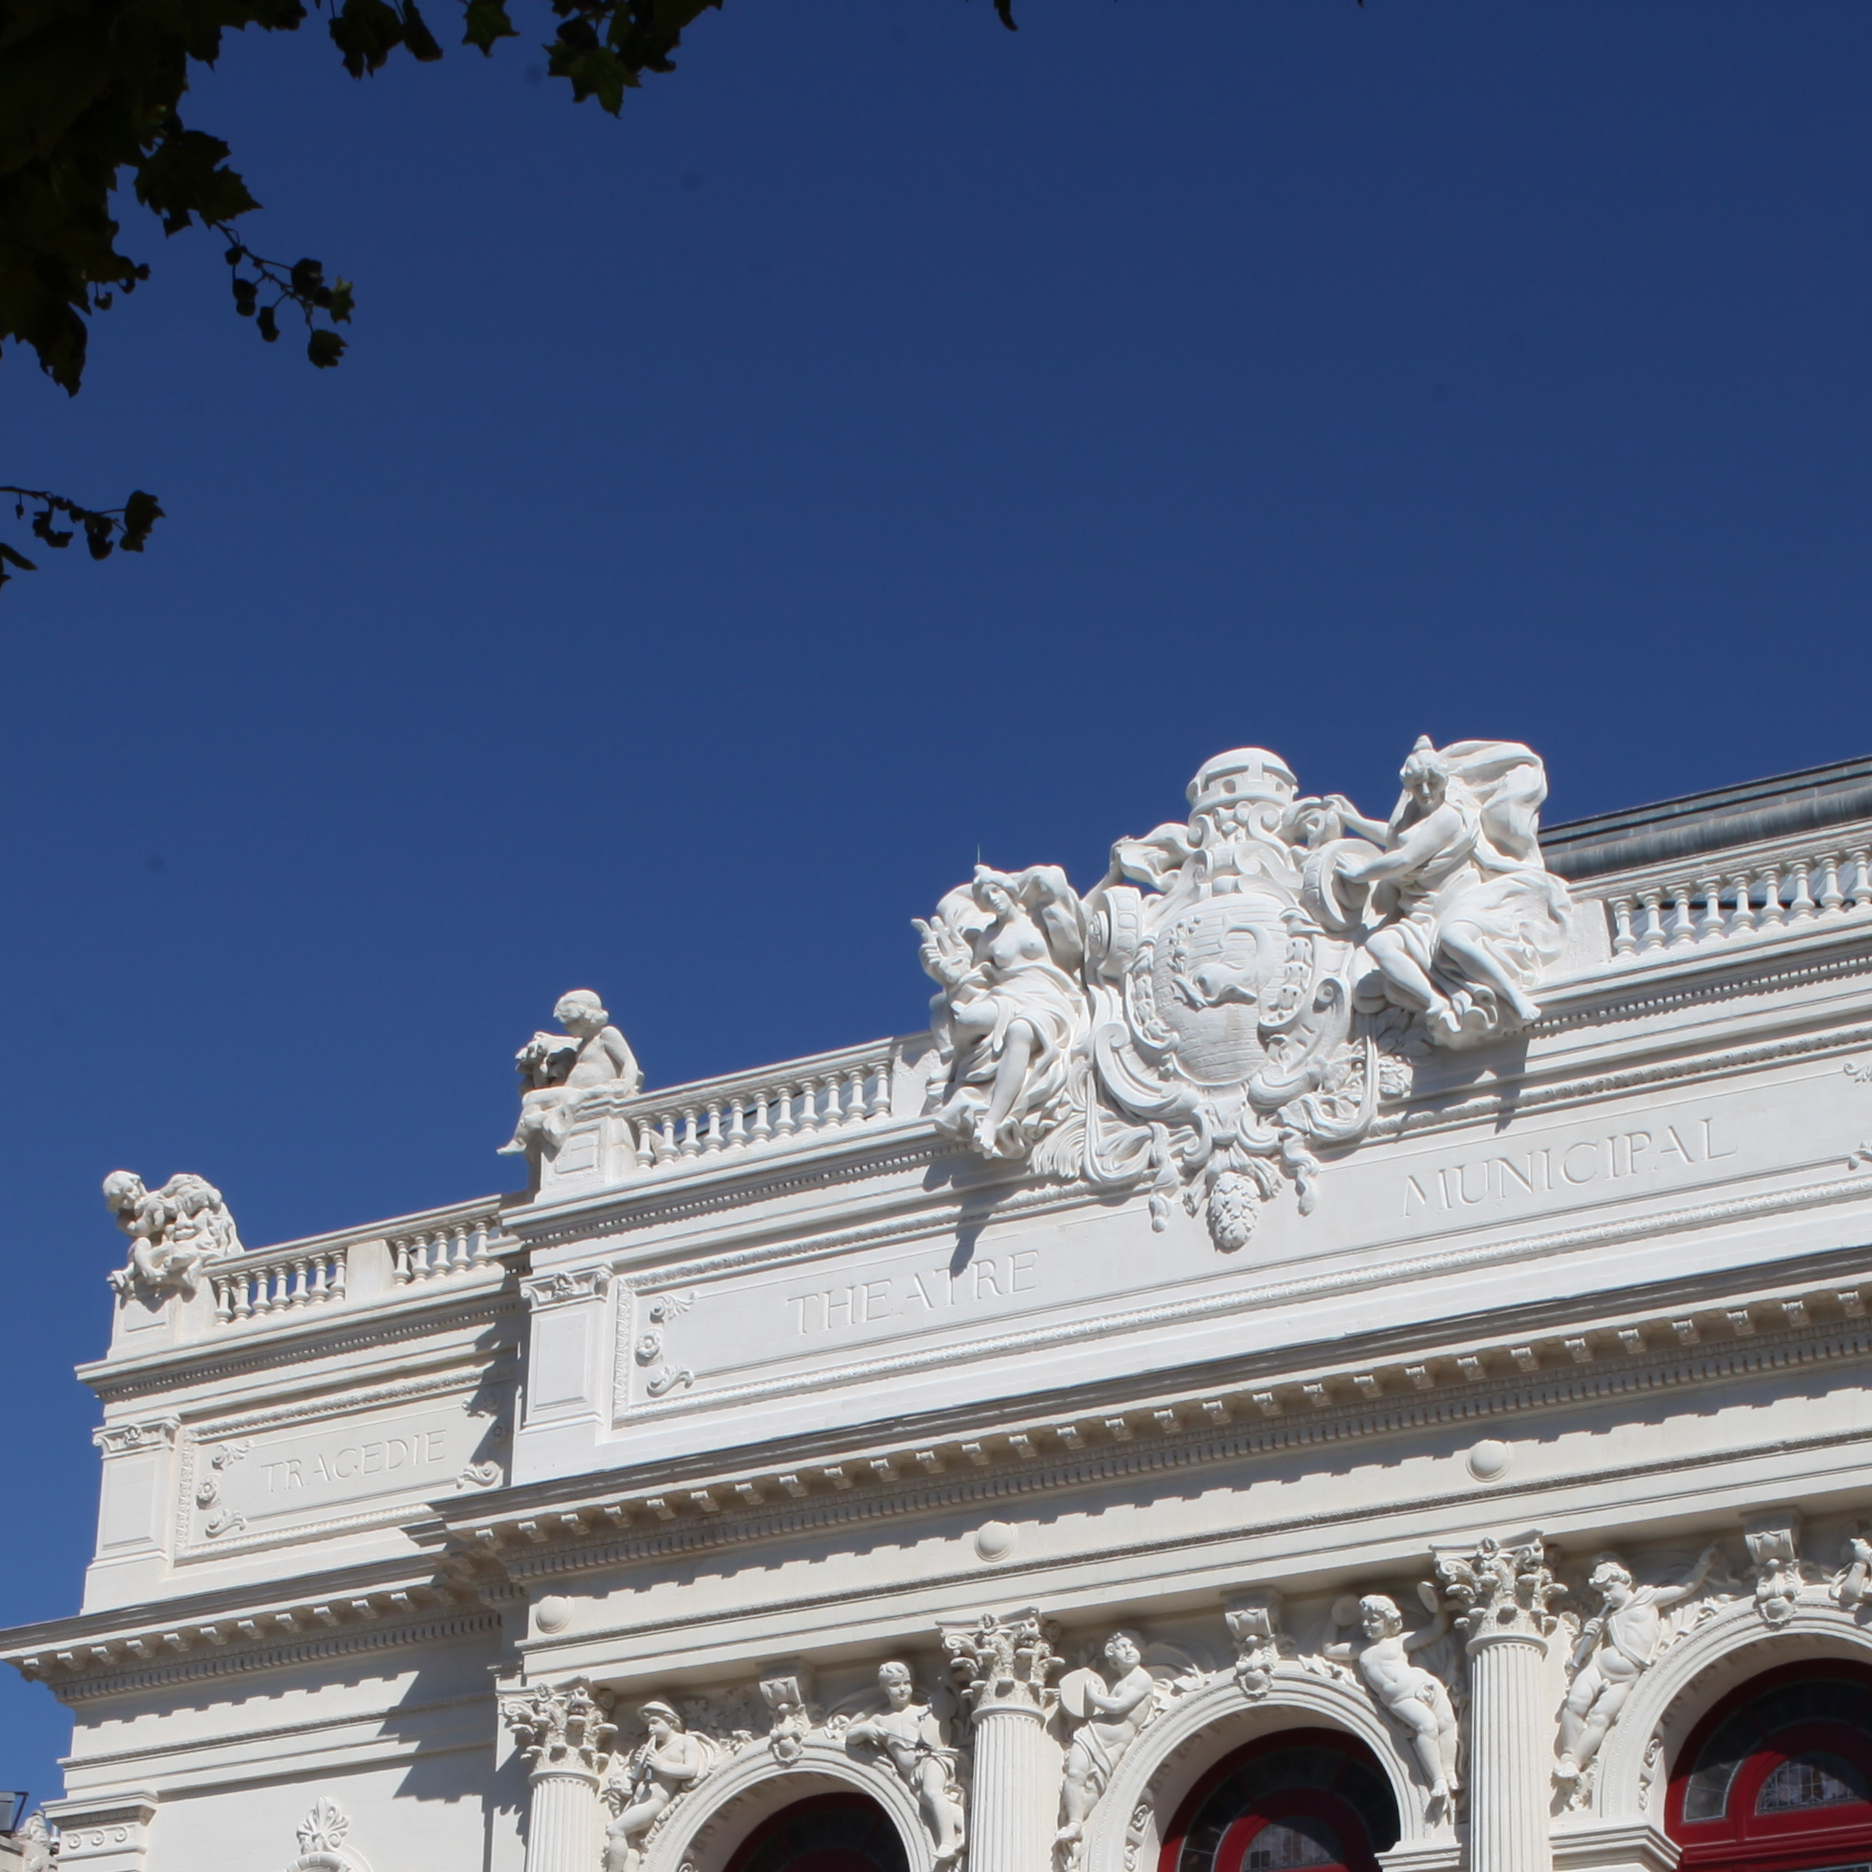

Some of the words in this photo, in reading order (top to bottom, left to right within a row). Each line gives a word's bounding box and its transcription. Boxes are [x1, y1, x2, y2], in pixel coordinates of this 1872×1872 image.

[785, 1249, 1040, 1336] THEATRE
[1401, 1117, 1736, 1218] MUNICIPAL
[260, 1429, 449, 1494] TRAGEDIE
